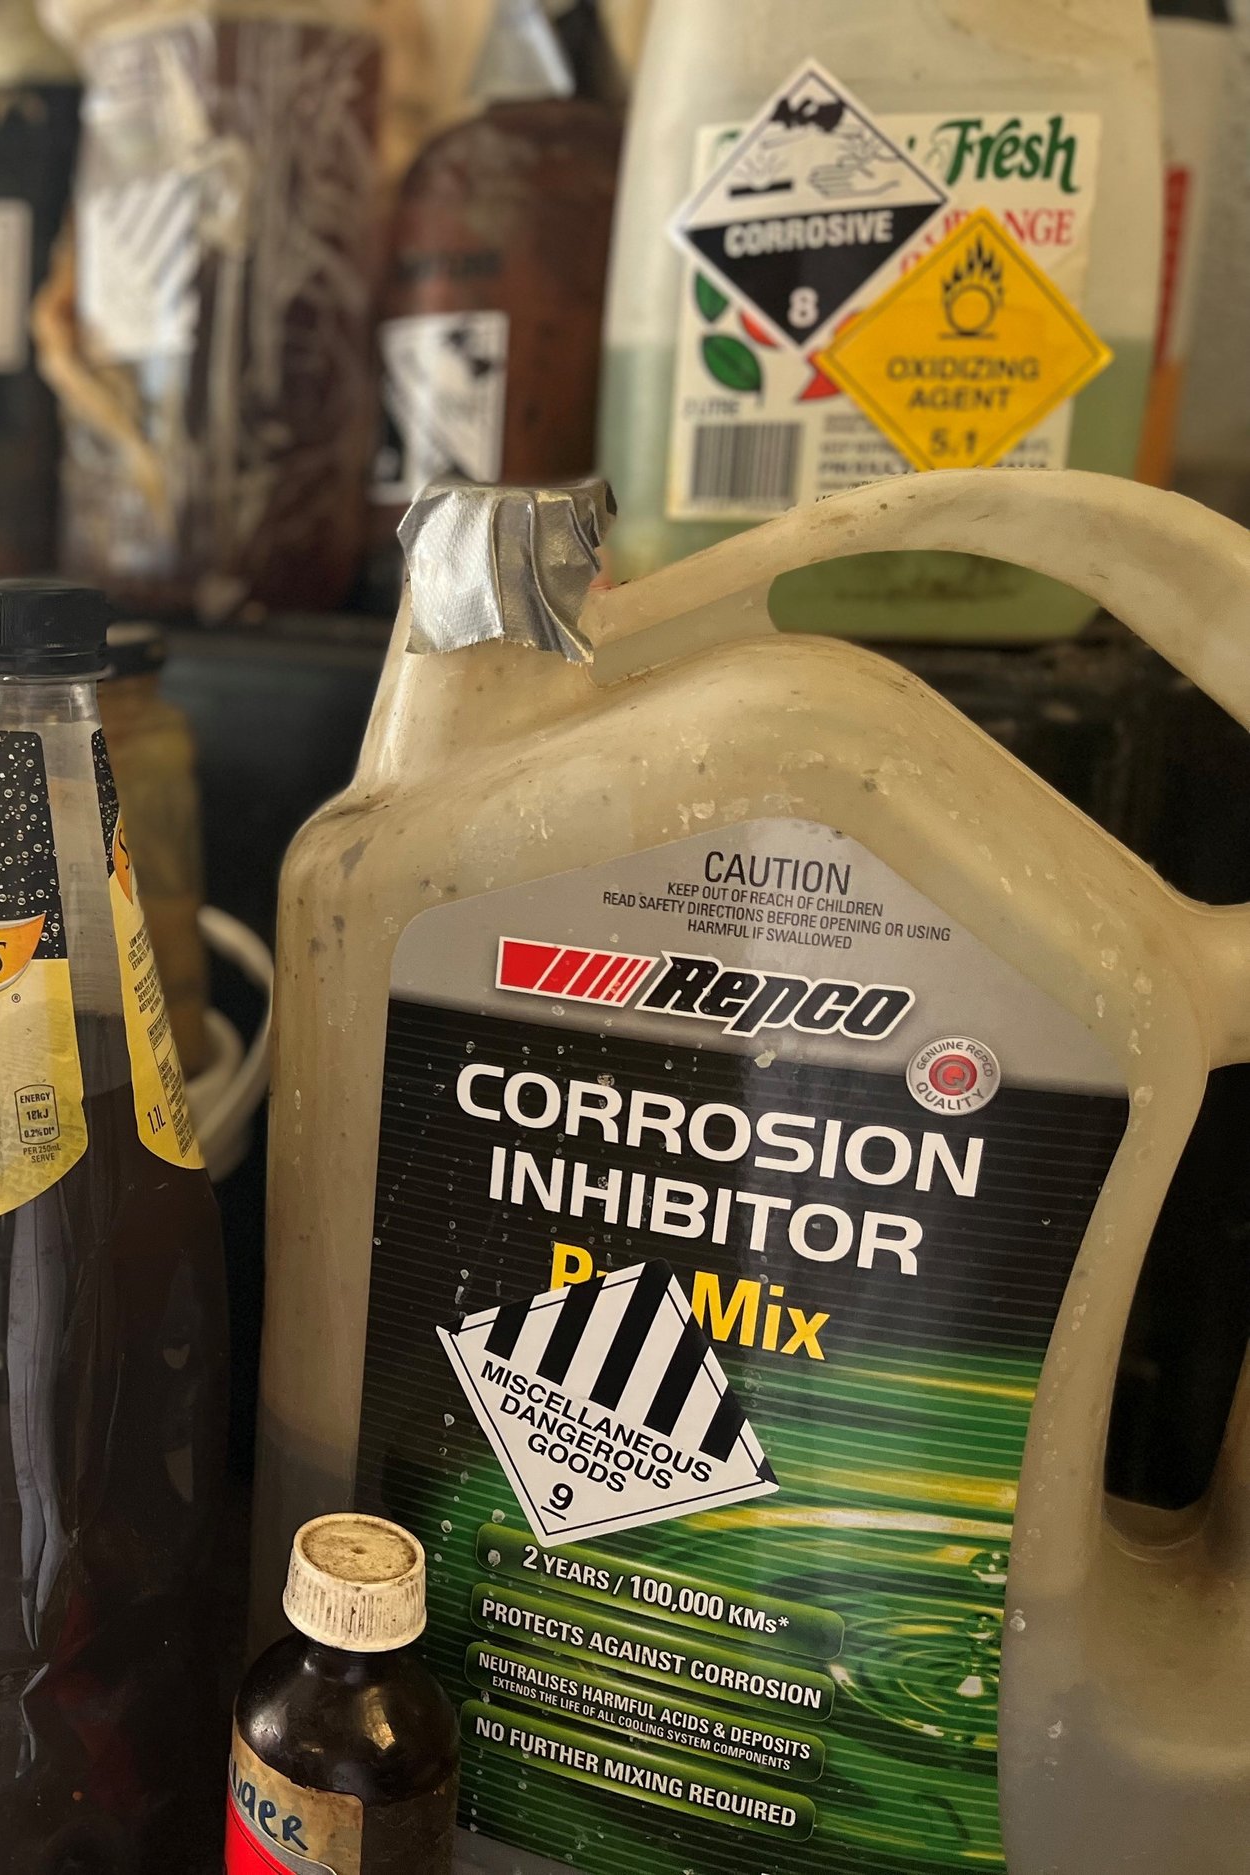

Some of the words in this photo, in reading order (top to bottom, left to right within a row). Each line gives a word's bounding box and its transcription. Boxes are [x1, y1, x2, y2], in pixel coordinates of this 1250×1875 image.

[935, 115, 1079, 194] Fresh
[724, 210, 894, 259] CORROSIVE
[787, 286, 819, 329] 8
[886, 355, 1041, 381] OXIDIZING
[909, 386, 1011, 411] AGENT
[931, 427, 978, 456] 5.1
[704, 851, 852, 896] CAUTION
[603, 891, 636, 907] READ
[638, 896, 685, 914] SAFETY
[687, 901, 764, 923] DIRECTIONS
[767, 910, 818, 928] BEFORE
[820, 916, 881, 935] OPENING
[885, 922, 903, 937] OR
[906, 925, 951, 942] USING
[667, 882, 700, 897] KEEP
[702, 886, 729, 901] OUT
[731, 889, 748, 903] OF
[750, 890, 794, 908] REACH
[797, 895, 814, 910] OF
[816, 897, 884, 917] CHILDREN
[687, 919, 749, 938] HARMFUL
[752, 927, 764, 940] IF
[766, 928, 852, 949] SWALLOWED
[636, 951, 916, 1040] Repco
[916, 1041, 964, 1070] GENUINE
[965, 1043, 994, 1078] REPCO
[19, 1092, 51, 1104] ENERGY
[26, 1108, 49, 1121] 18kJ
[915, 1081, 985, 1111] QUALITY
[24, 1129, 42, 1138] 0.2%
[147, 1104, 167, 1135] 1.1L
[456, 1063, 984, 1198] CORROSION
[23, 1145, 38, 1155] PER
[39, 1143, 62, 1153] 250mL
[31, 1153, 55, 1164] SERVE
[489, 1146, 924, 1276] INHIBITOR
[691, 1271, 830, 1360] Mix
[480, 1360, 713, 1483] MISCELLANEOUS
[500, 1393, 674, 1490] DANGEROUS
[527, 1433, 627, 1493] GOODS
[549, 1482, 575, 1512] 9
[522, 1544, 539, 1571] 2
[542, 1553, 610, 1591] YEARS
[612, 1575, 624, 1596] /
[630, 1574, 724, 1621] 100,000
[481, 1598, 584, 1646] PROTECTS
[587, 1631, 687, 1675] AGAINST
[689, 1660, 823, 1710] CORROSION
[478, 1652, 578, 1697] NEUTRALISES
[581, 1684, 658, 1721] HARMFUL
[659, 1708, 710, 1735] ACIDS
[712, 1722, 726, 1740] &
[730, 1726, 812, 1760] DEPOSITS
[492, 1675, 537, 1699] EXTENDS
[539, 1690, 558, 1706] THE
[560, 1697, 580, 1713] LIFE
[582, 1704, 596, 1717] OF
[596, 1709, 616, 1724] ALL
[618, 1715, 664, 1738] COOLING
[666, 1730, 711, 1751] SYSTEM
[713, 1741, 791, 1771] COMPONENTS
[476, 1716, 505, 1742] NO
[509, 1728, 599, 1774] FURTHER
[603, 1758, 683, 1798] MIXING
[688, 1783, 797, 1828] REQUIRED
